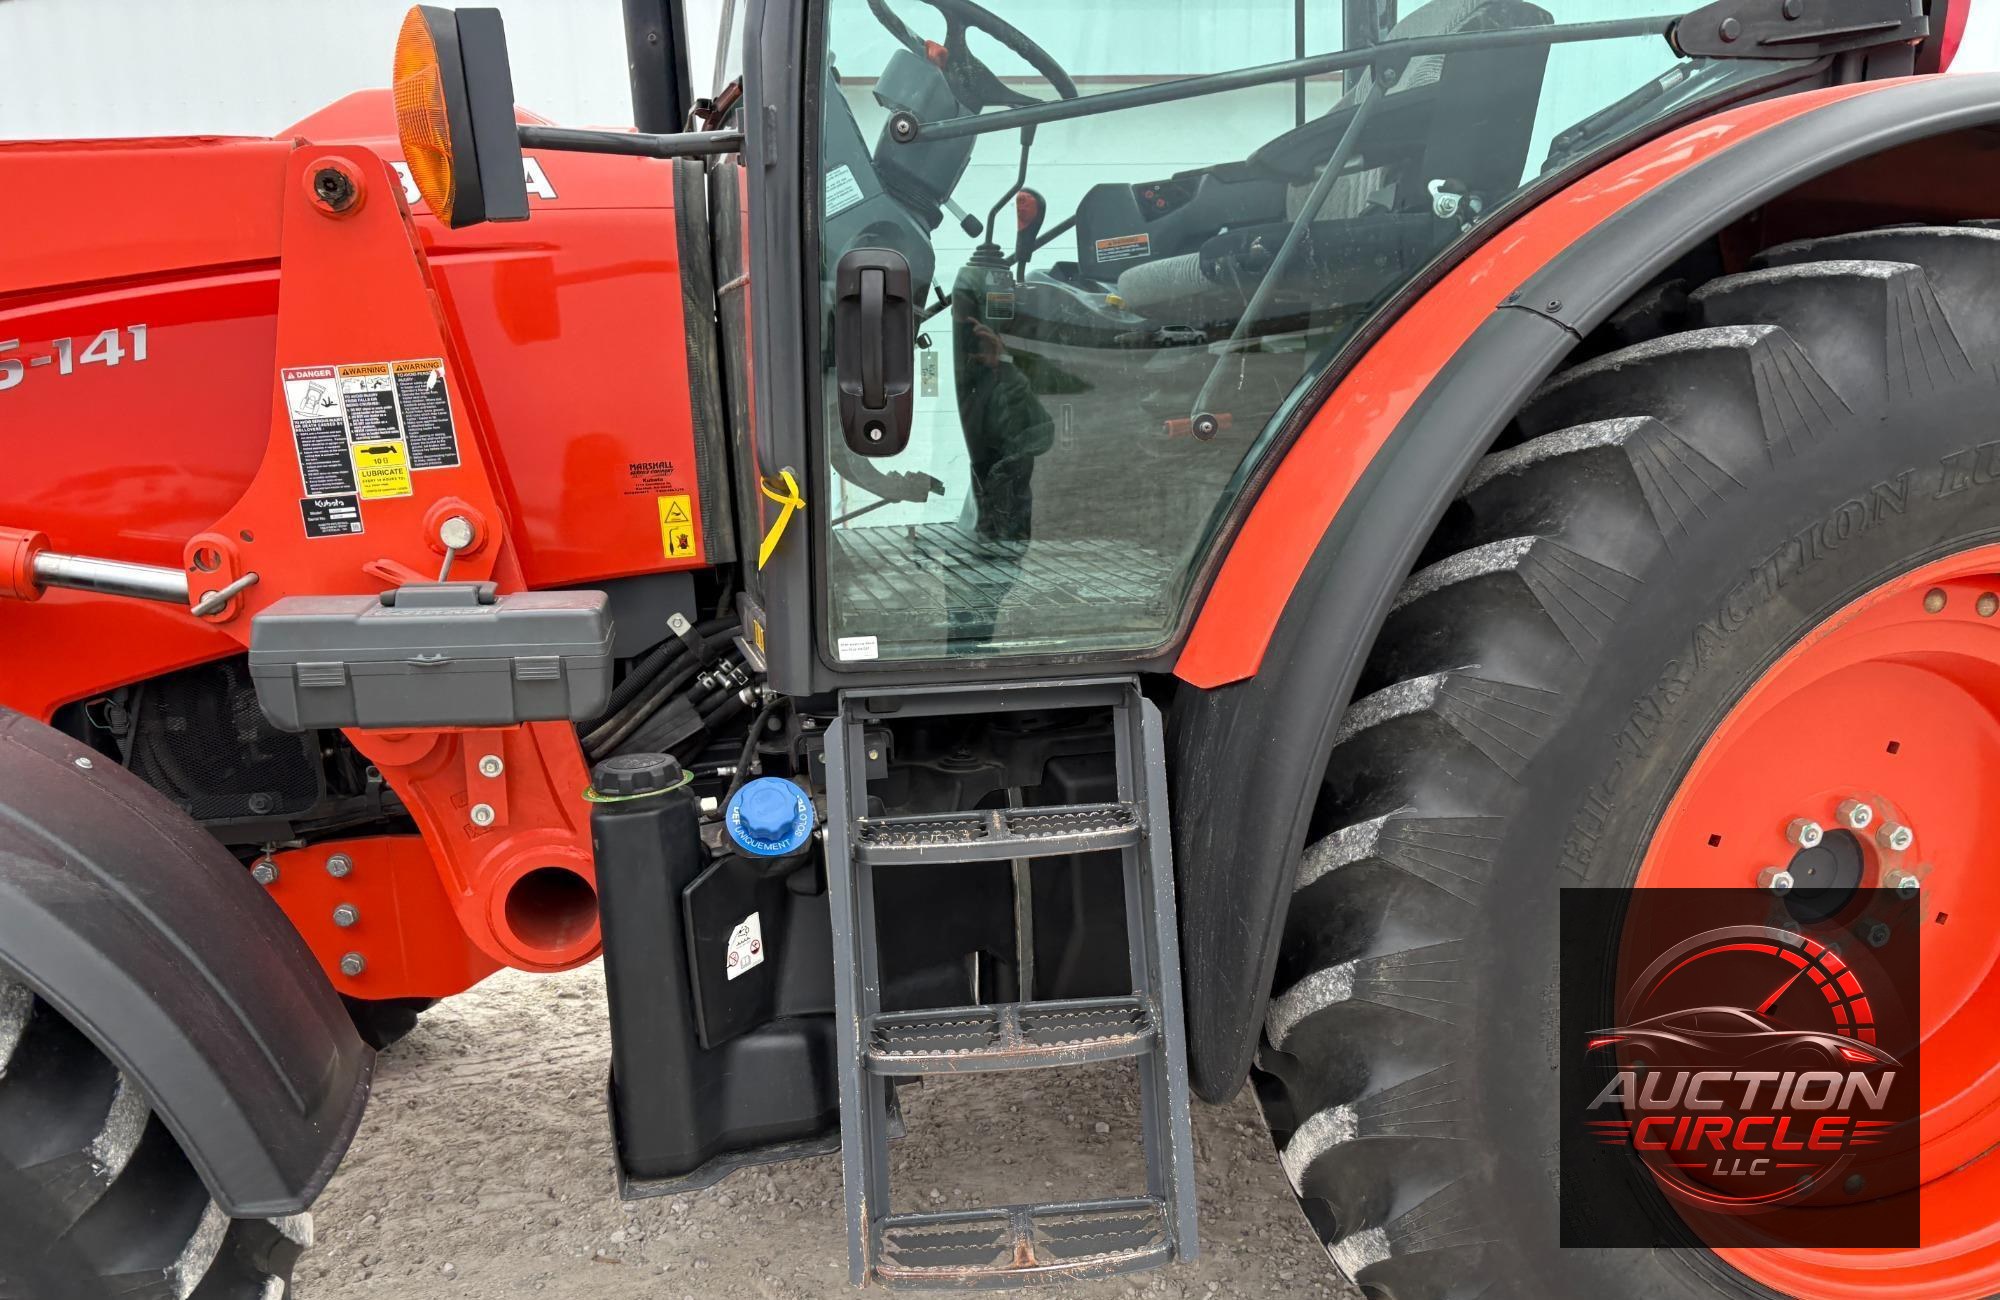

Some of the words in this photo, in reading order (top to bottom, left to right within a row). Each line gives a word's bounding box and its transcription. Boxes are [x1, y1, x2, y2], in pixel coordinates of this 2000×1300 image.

[402, 361, 439, 370] WARNING
[296, 370, 332, 379] DANGER
[349, 366, 386, 375] WARNING
[629, 462, 673, 470] MARSHALL
[362, 468, 403, 477] LUBRICATE
[315, 500, 344, 508] Kubota
[735, 826, 790, 851] UNIQUEMENT
